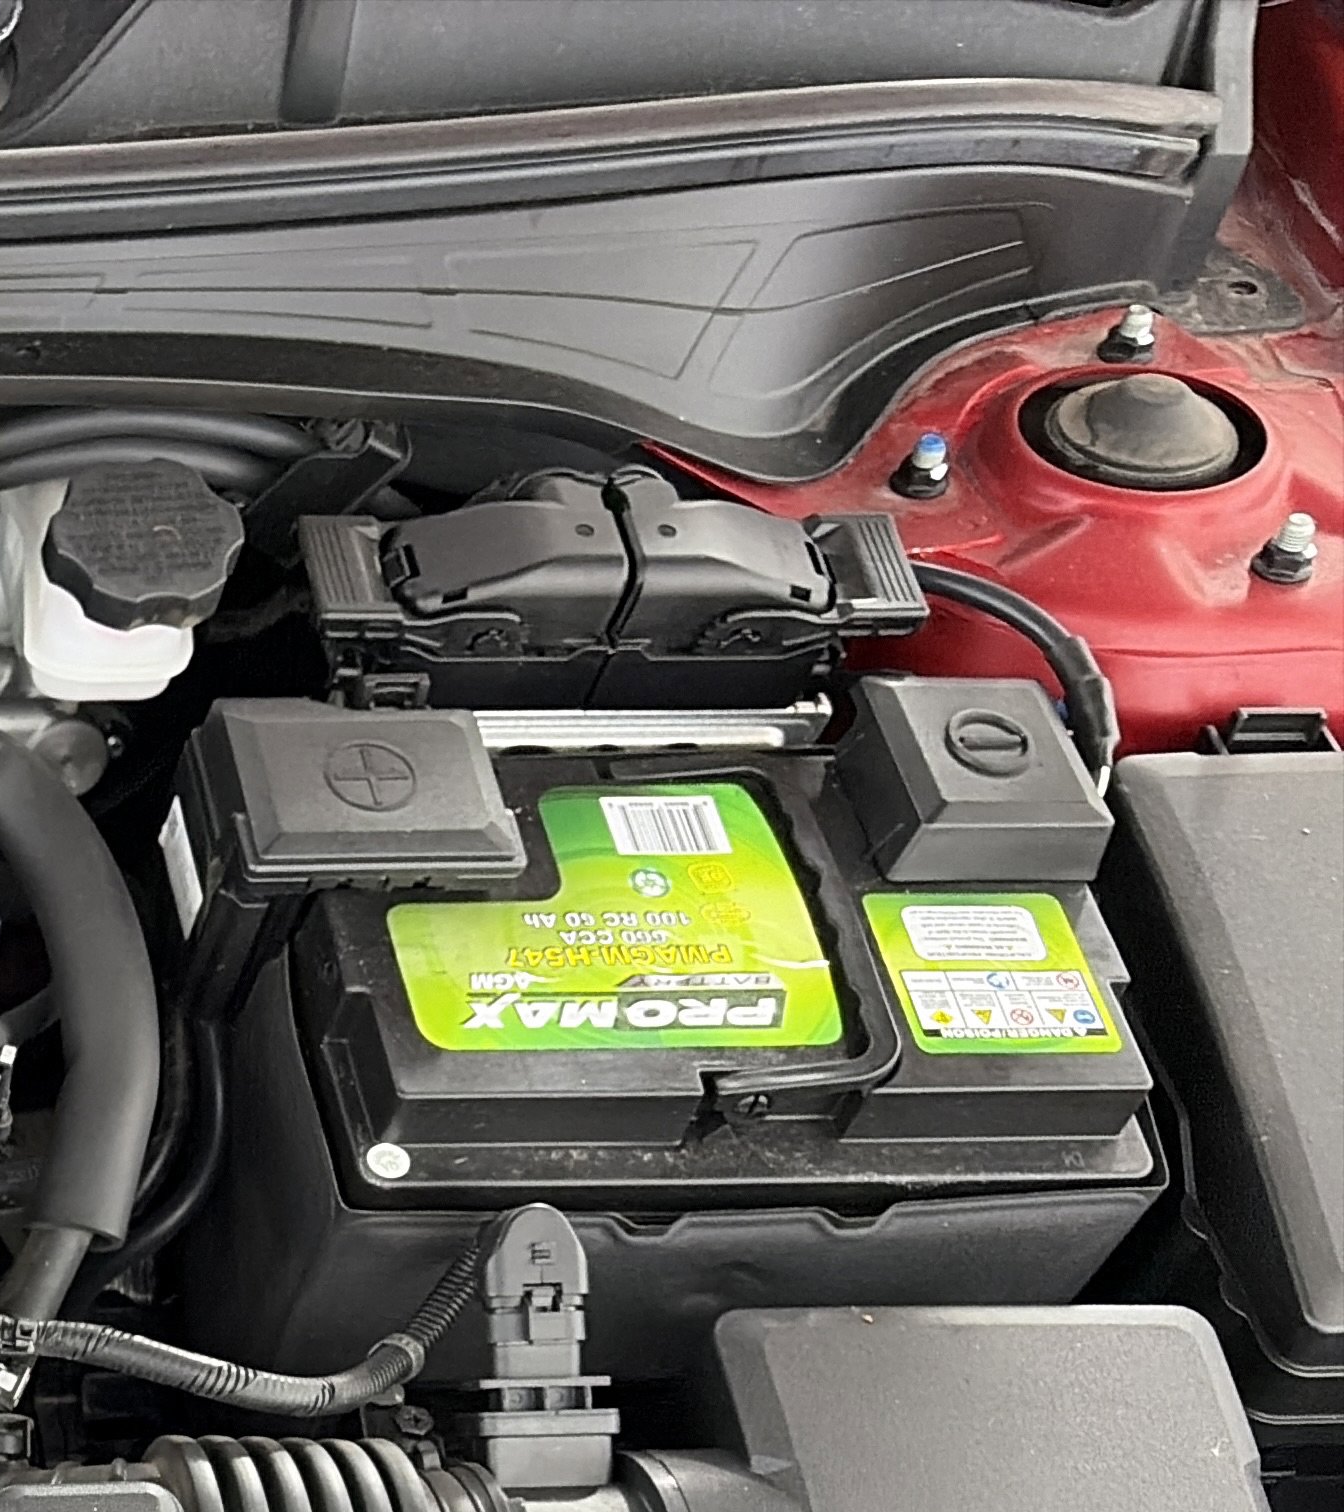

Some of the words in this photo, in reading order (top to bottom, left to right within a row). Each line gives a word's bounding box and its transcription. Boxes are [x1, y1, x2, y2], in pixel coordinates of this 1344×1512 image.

[523, 911, 557, 929] Ah
[603, 911, 638, 927] RC
[647, 911, 692, 927] 100
[560, 929, 614, 946] CCA
[506, 944, 734, 968] PMAGM-H547
[470, 971, 532, 991] AGM
[644, 974, 772, 987] BATTERY
[462, 992, 778, 1029] PROMAX
